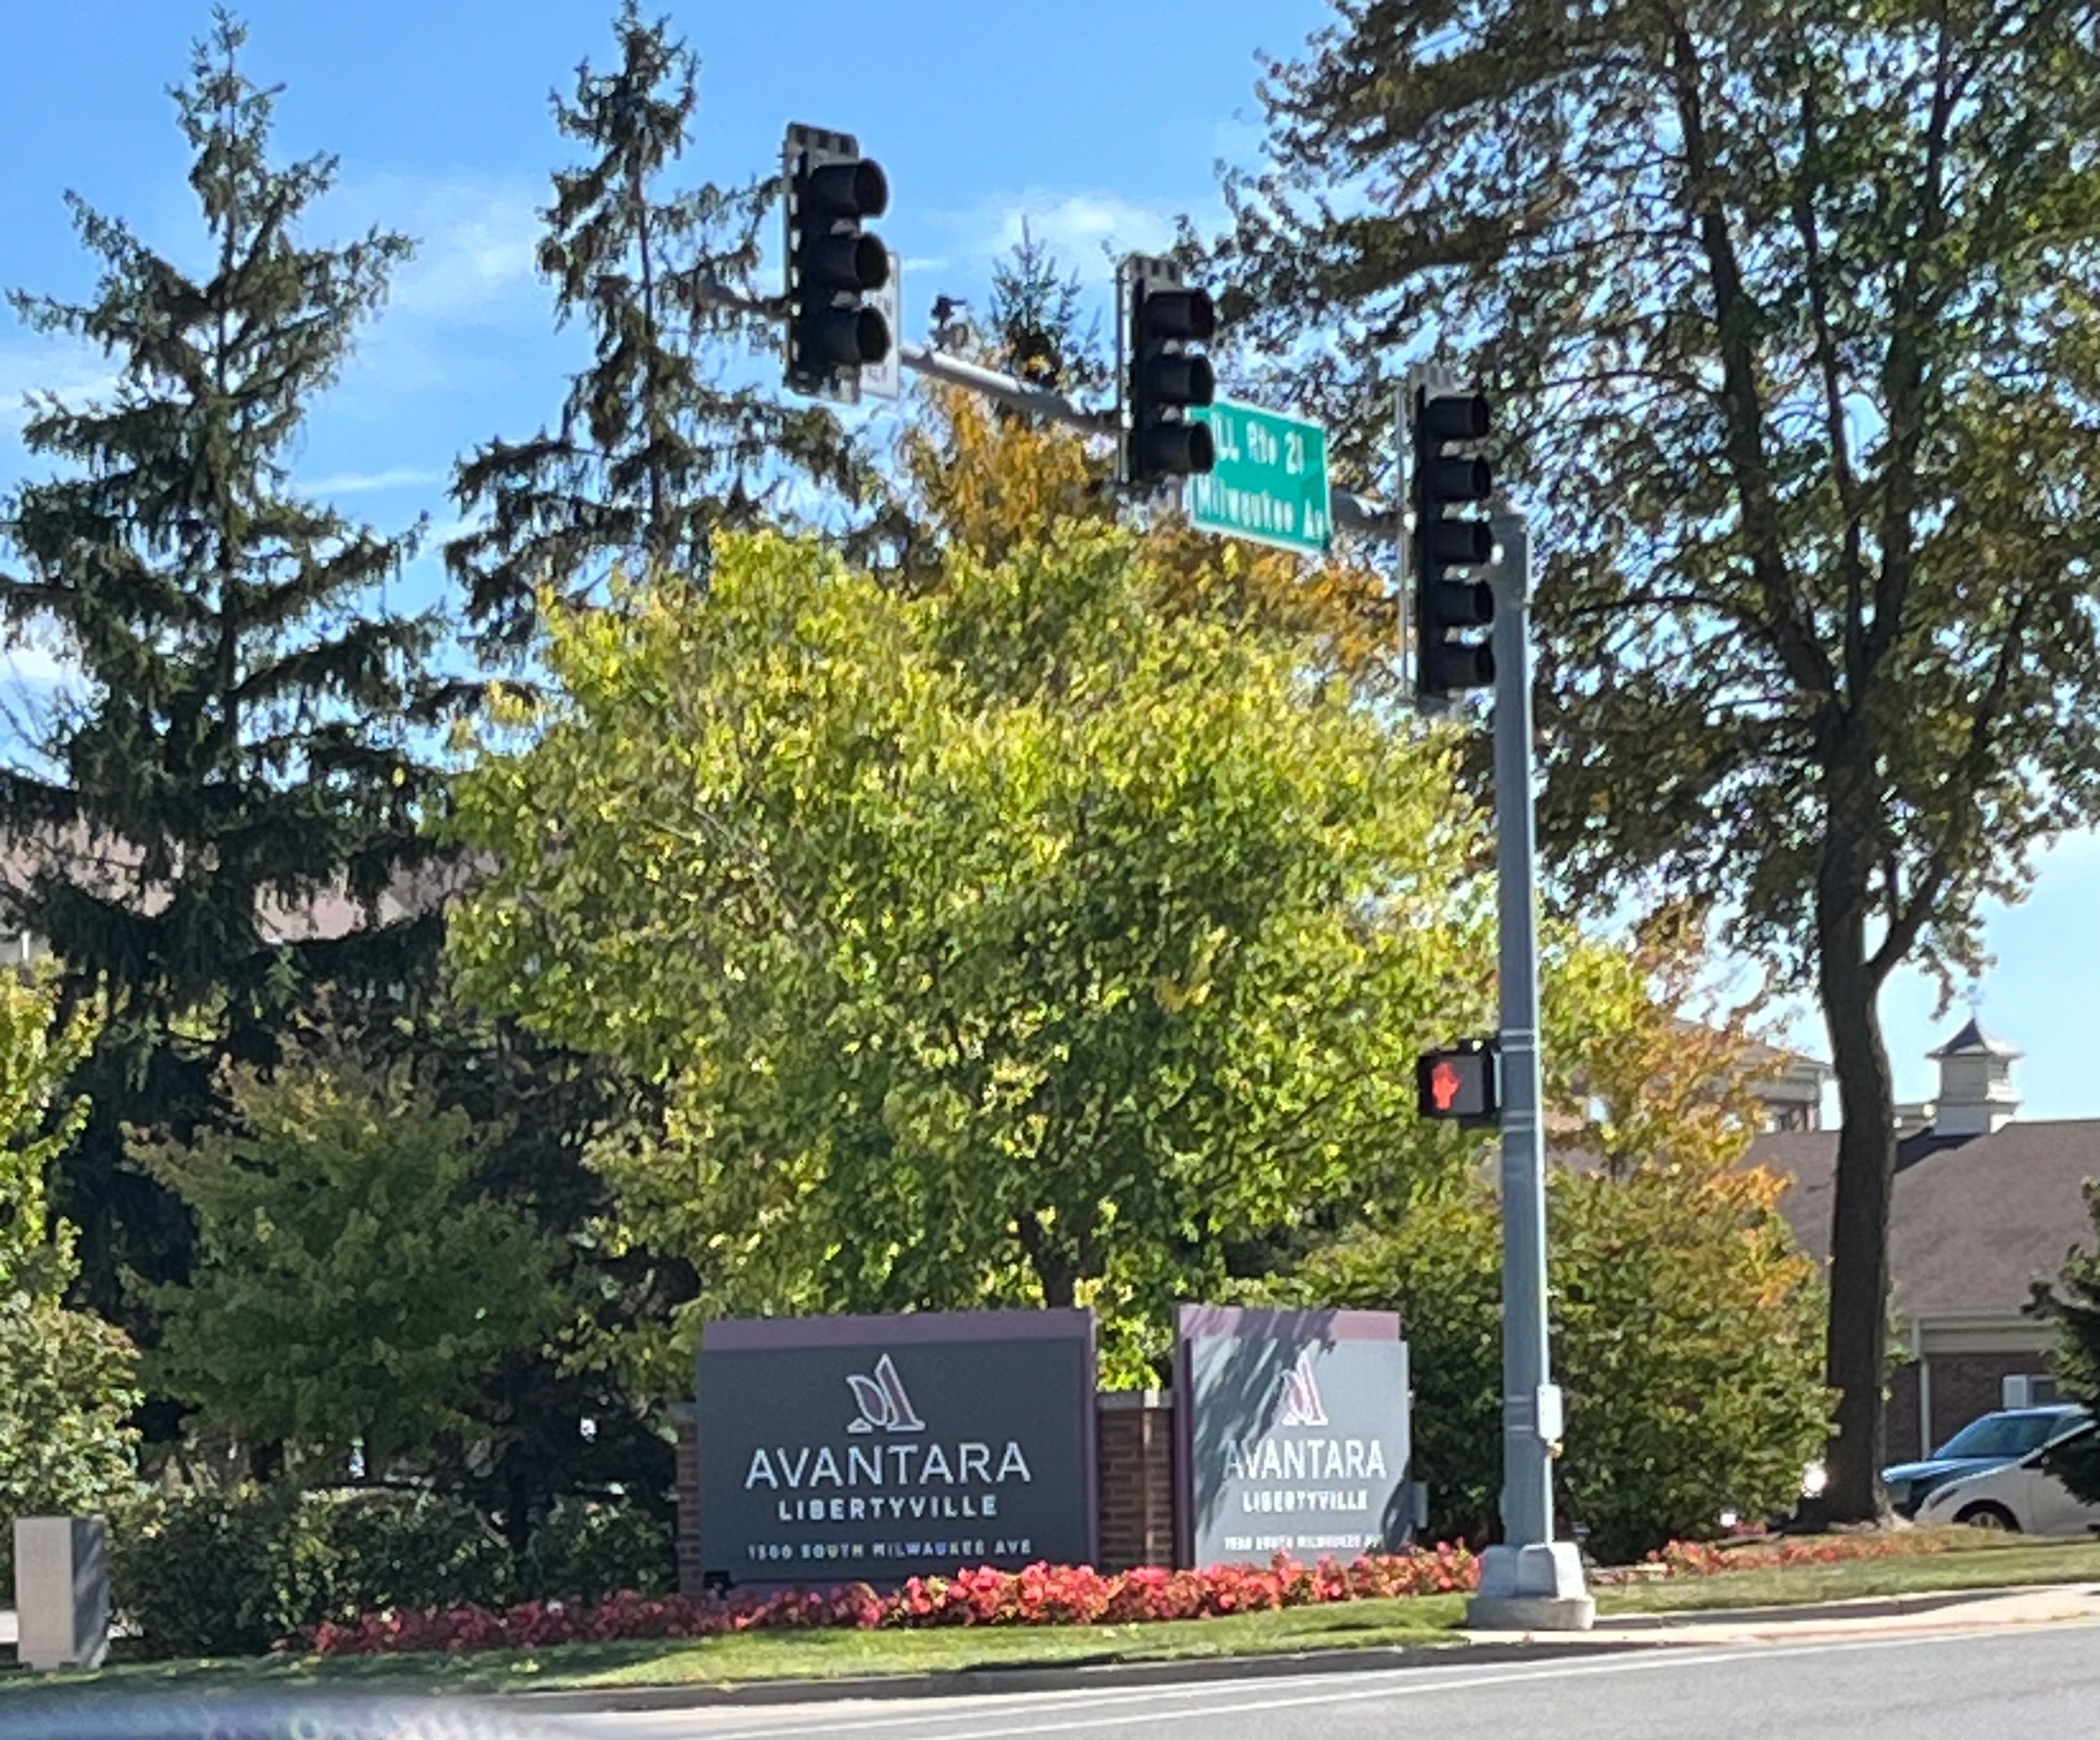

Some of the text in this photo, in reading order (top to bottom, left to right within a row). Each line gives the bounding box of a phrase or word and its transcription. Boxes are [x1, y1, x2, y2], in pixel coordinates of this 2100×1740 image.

[744, 1441, 1032, 1490] AVANTARA
[1223, 1439, 1388, 1480] AVANTARA
[778, 1494, 998, 1521] LIBERTYVILLE
[801, 1541, 864, 1559] SOUTH
[872, 1539, 985, 1558] MILWAUKEE
[994, 1538, 1031, 1555] AVE
